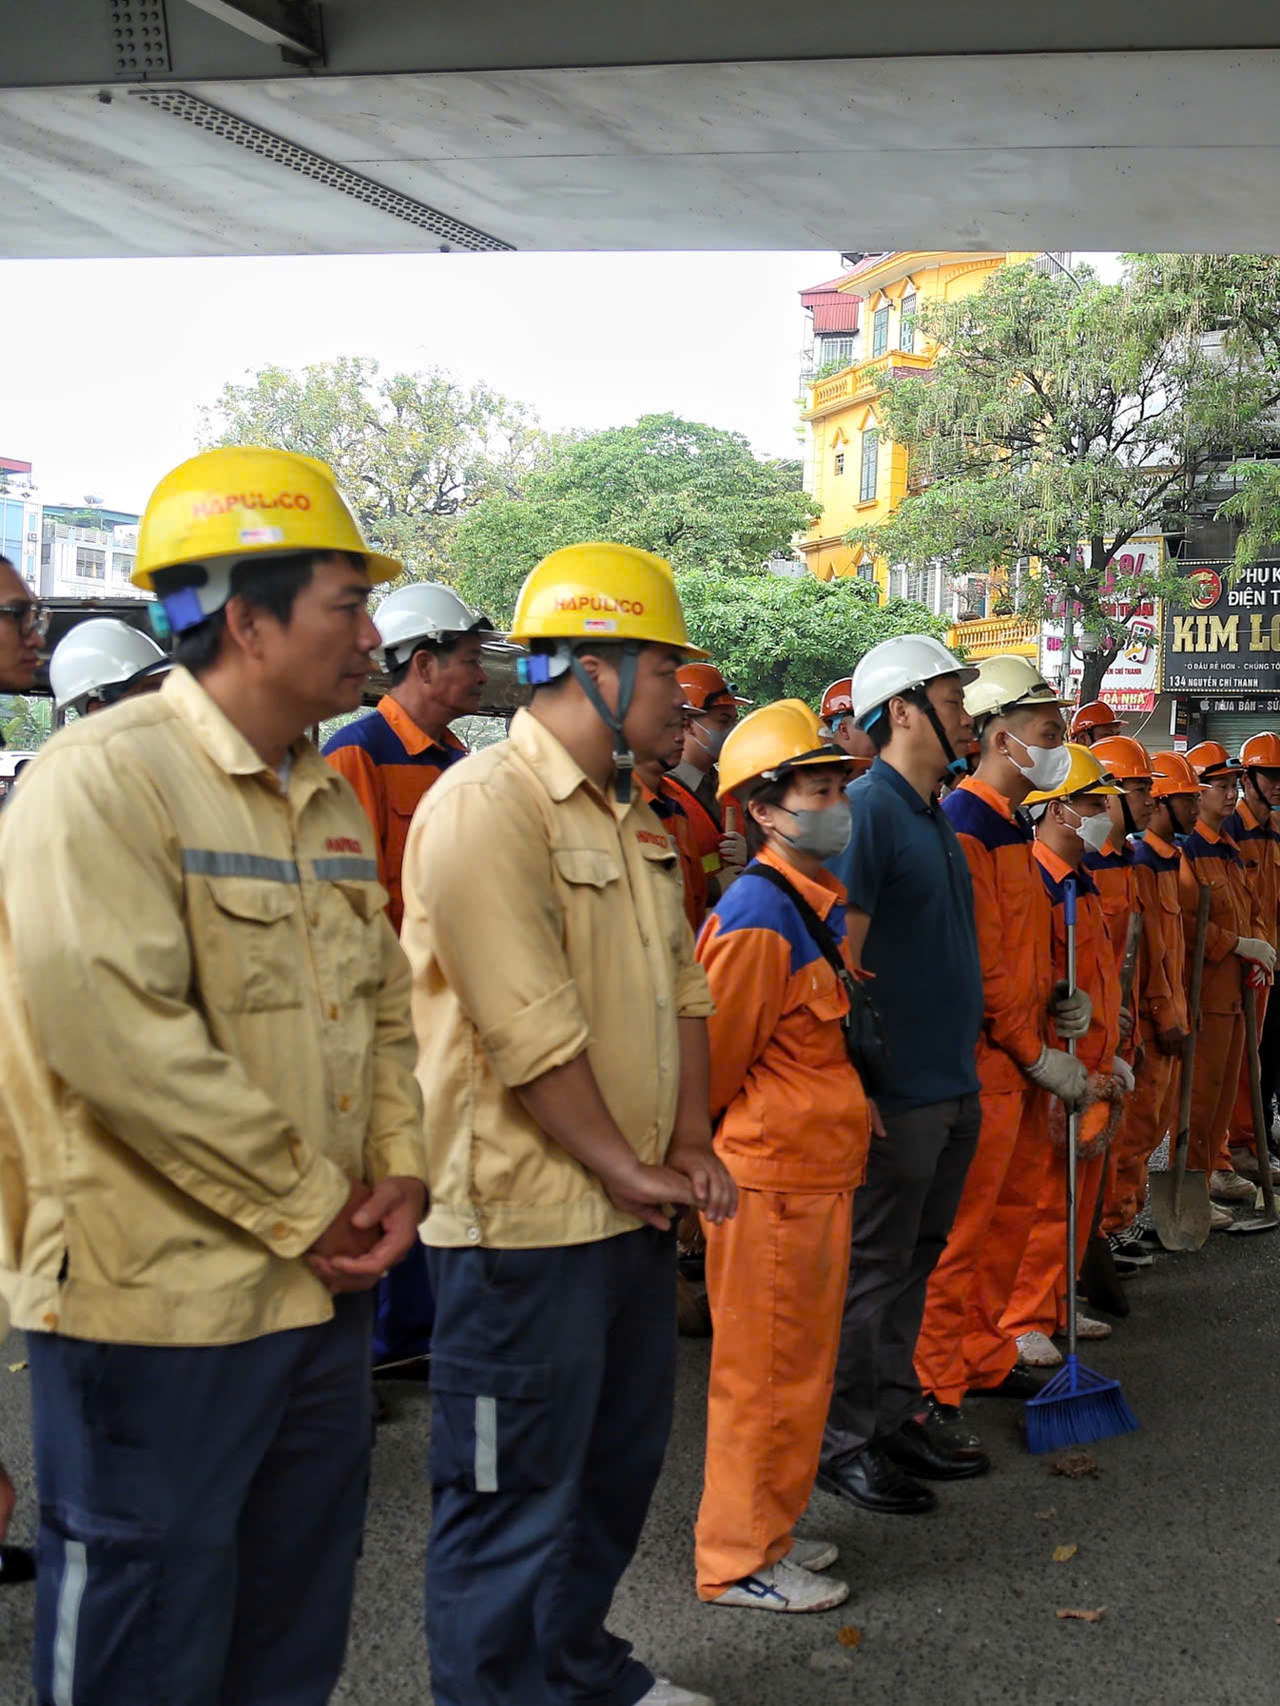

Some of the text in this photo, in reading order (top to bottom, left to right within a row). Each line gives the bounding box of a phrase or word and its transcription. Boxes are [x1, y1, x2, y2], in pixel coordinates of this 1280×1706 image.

[192, 491, 312, 520] HAPULICO
[1237, 567, 1270, 586] PHỤ
[554, 596, 644, 616] HAPULICO
[1228, 587, 1265, 609] ĐIỆN
[1172, 614, 1239, 653] KIM
[1169, 675, 1186, 687] 134
[1219, 677, 1232, 687] CHÍ
[1233, 679, 1259, 687] THANH
